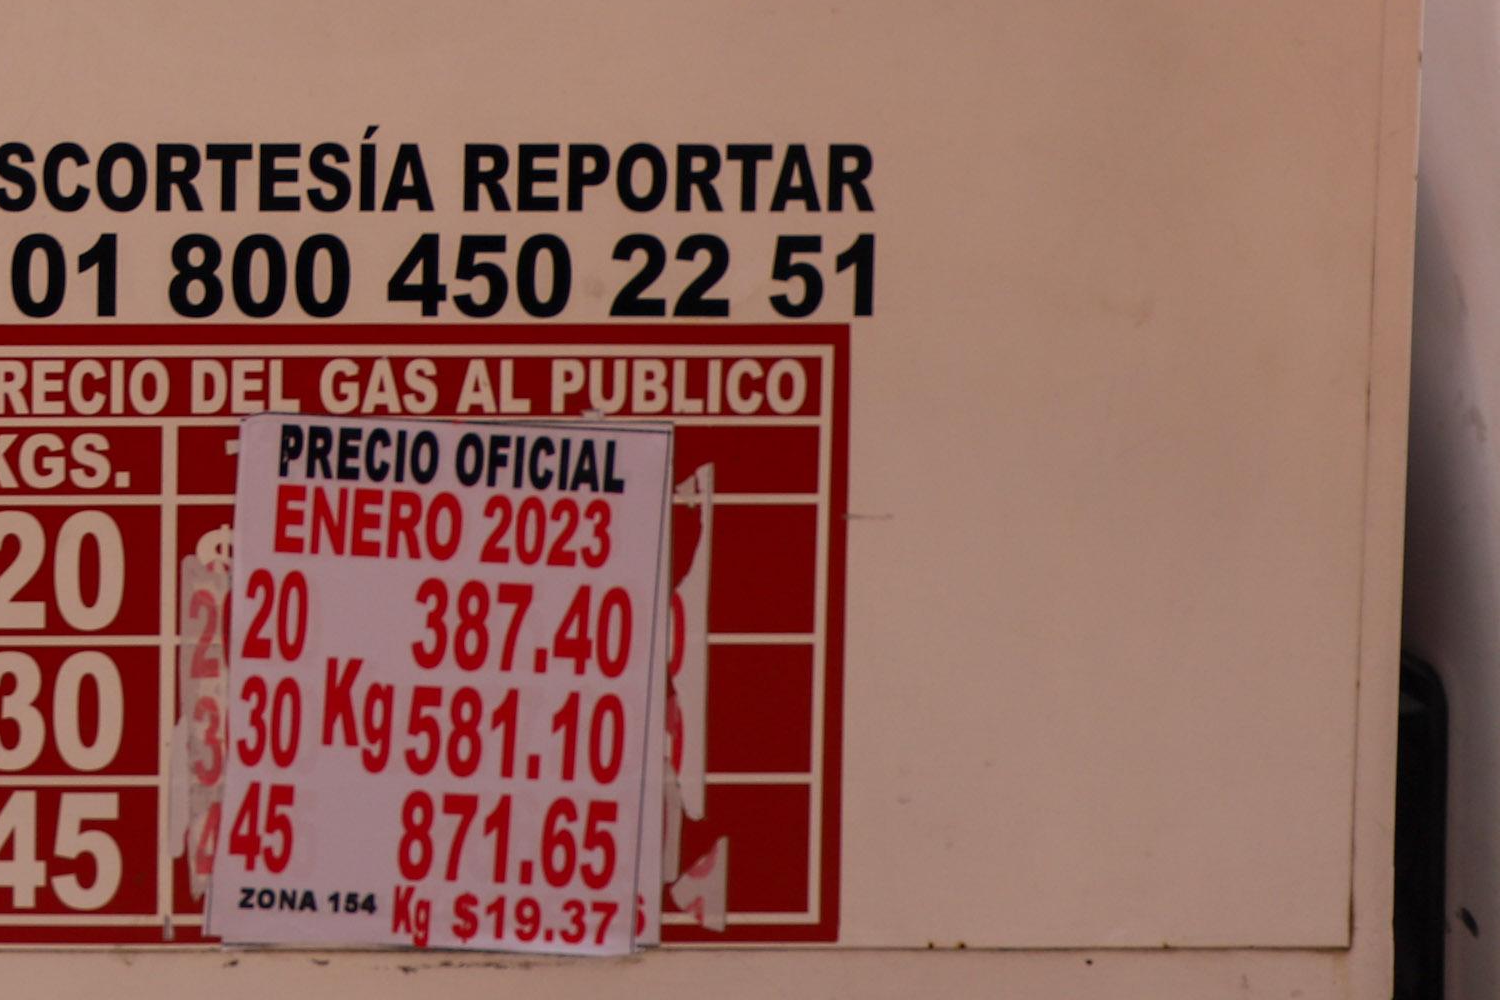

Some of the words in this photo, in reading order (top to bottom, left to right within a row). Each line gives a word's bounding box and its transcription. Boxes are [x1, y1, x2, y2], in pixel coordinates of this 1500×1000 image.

[463, 143, 874, 213] REPORTAR
[11, 233, 117, 318] 01
[168, 233, 351, 318] 800
[387, 233, 572, 318] 450
[609, 233, 730, 318] 22
[769, 233, 875, 318] 51
[191, 358, 300, 415] DEL
[320, 358, 438, 414] GAS
[456, 358, 531, 413] AL
[550, 358, 808, 414] PUBLICO
[278, 424, 440, 485] PRECIO
[455, 432, 625, 494] OFICIAL
[273, 483, 464, 562] ENERO
[479, 493, 612, 570] 2023
[241, 567, 309, 663] 20
[411, 577, 634, 679] 387.40
[236, 674, 303, 769] 30
[322, 657, 395, 775] Kg
[404, 685, 626, 786] 581.10
[228, 780, 296, 875] 45
[397, 789, 619, 891] 871.65
[238, 888, 317, 912] ZONA
[328, 892, 377, 915] 154
[391, 885, 432, 949] Kg
[451, 892, 619, 946] $19.37
